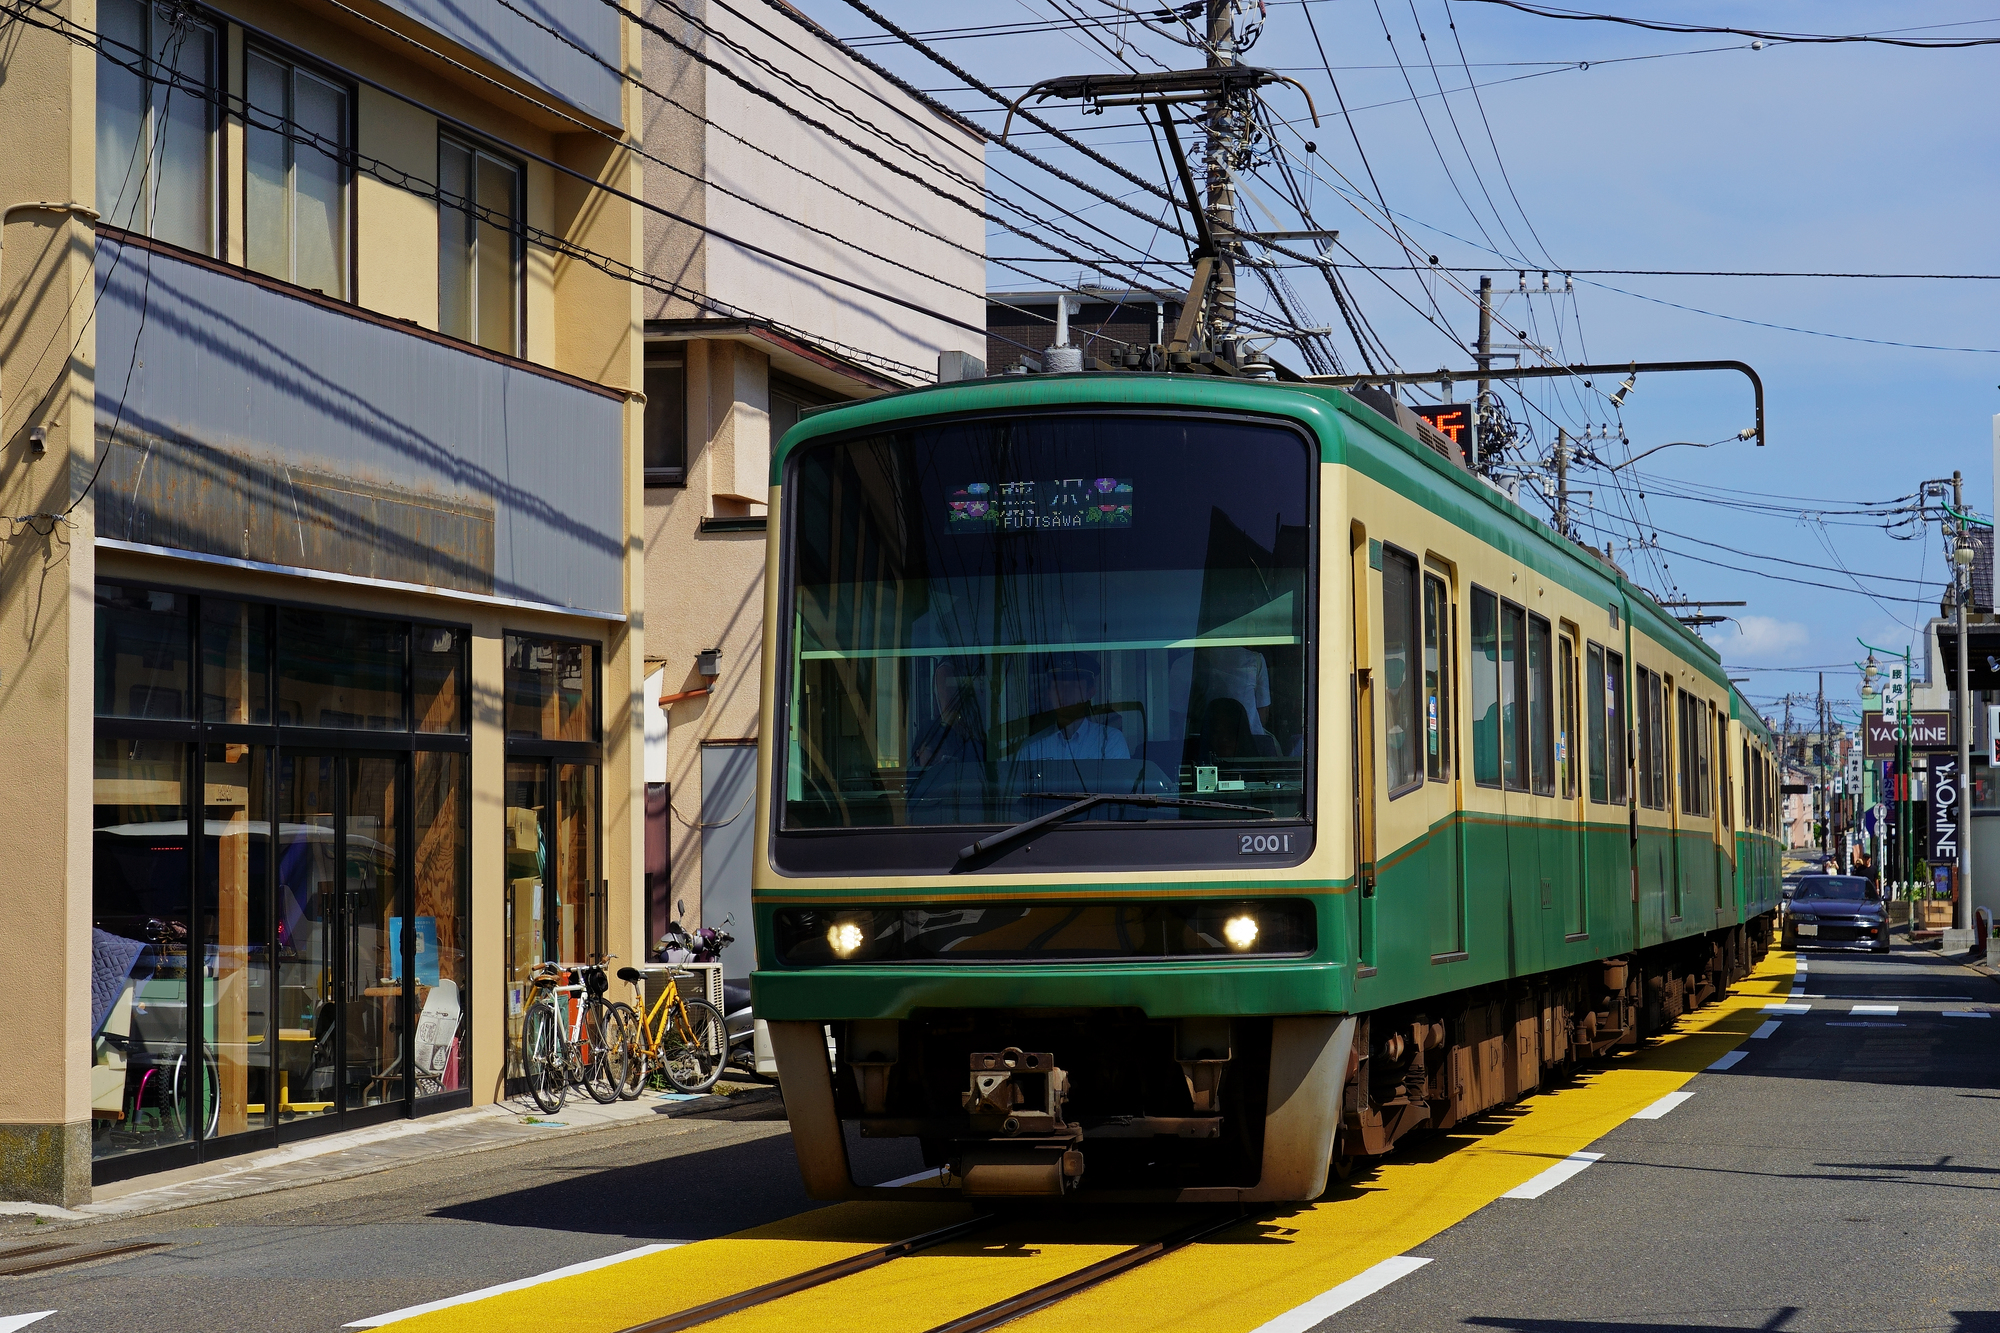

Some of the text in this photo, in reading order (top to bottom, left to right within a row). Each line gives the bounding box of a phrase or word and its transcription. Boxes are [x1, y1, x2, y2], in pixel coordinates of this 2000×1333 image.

[1004, 515, 1081, 528] FUJISAWA
[1892, 669, 1902, 693] 腰越
[1870, 727, 1946, 741] YAOMINE
[1935, 761, 1956, 857] YAOMINE
[1242, 835, 1289, 852] 2001
